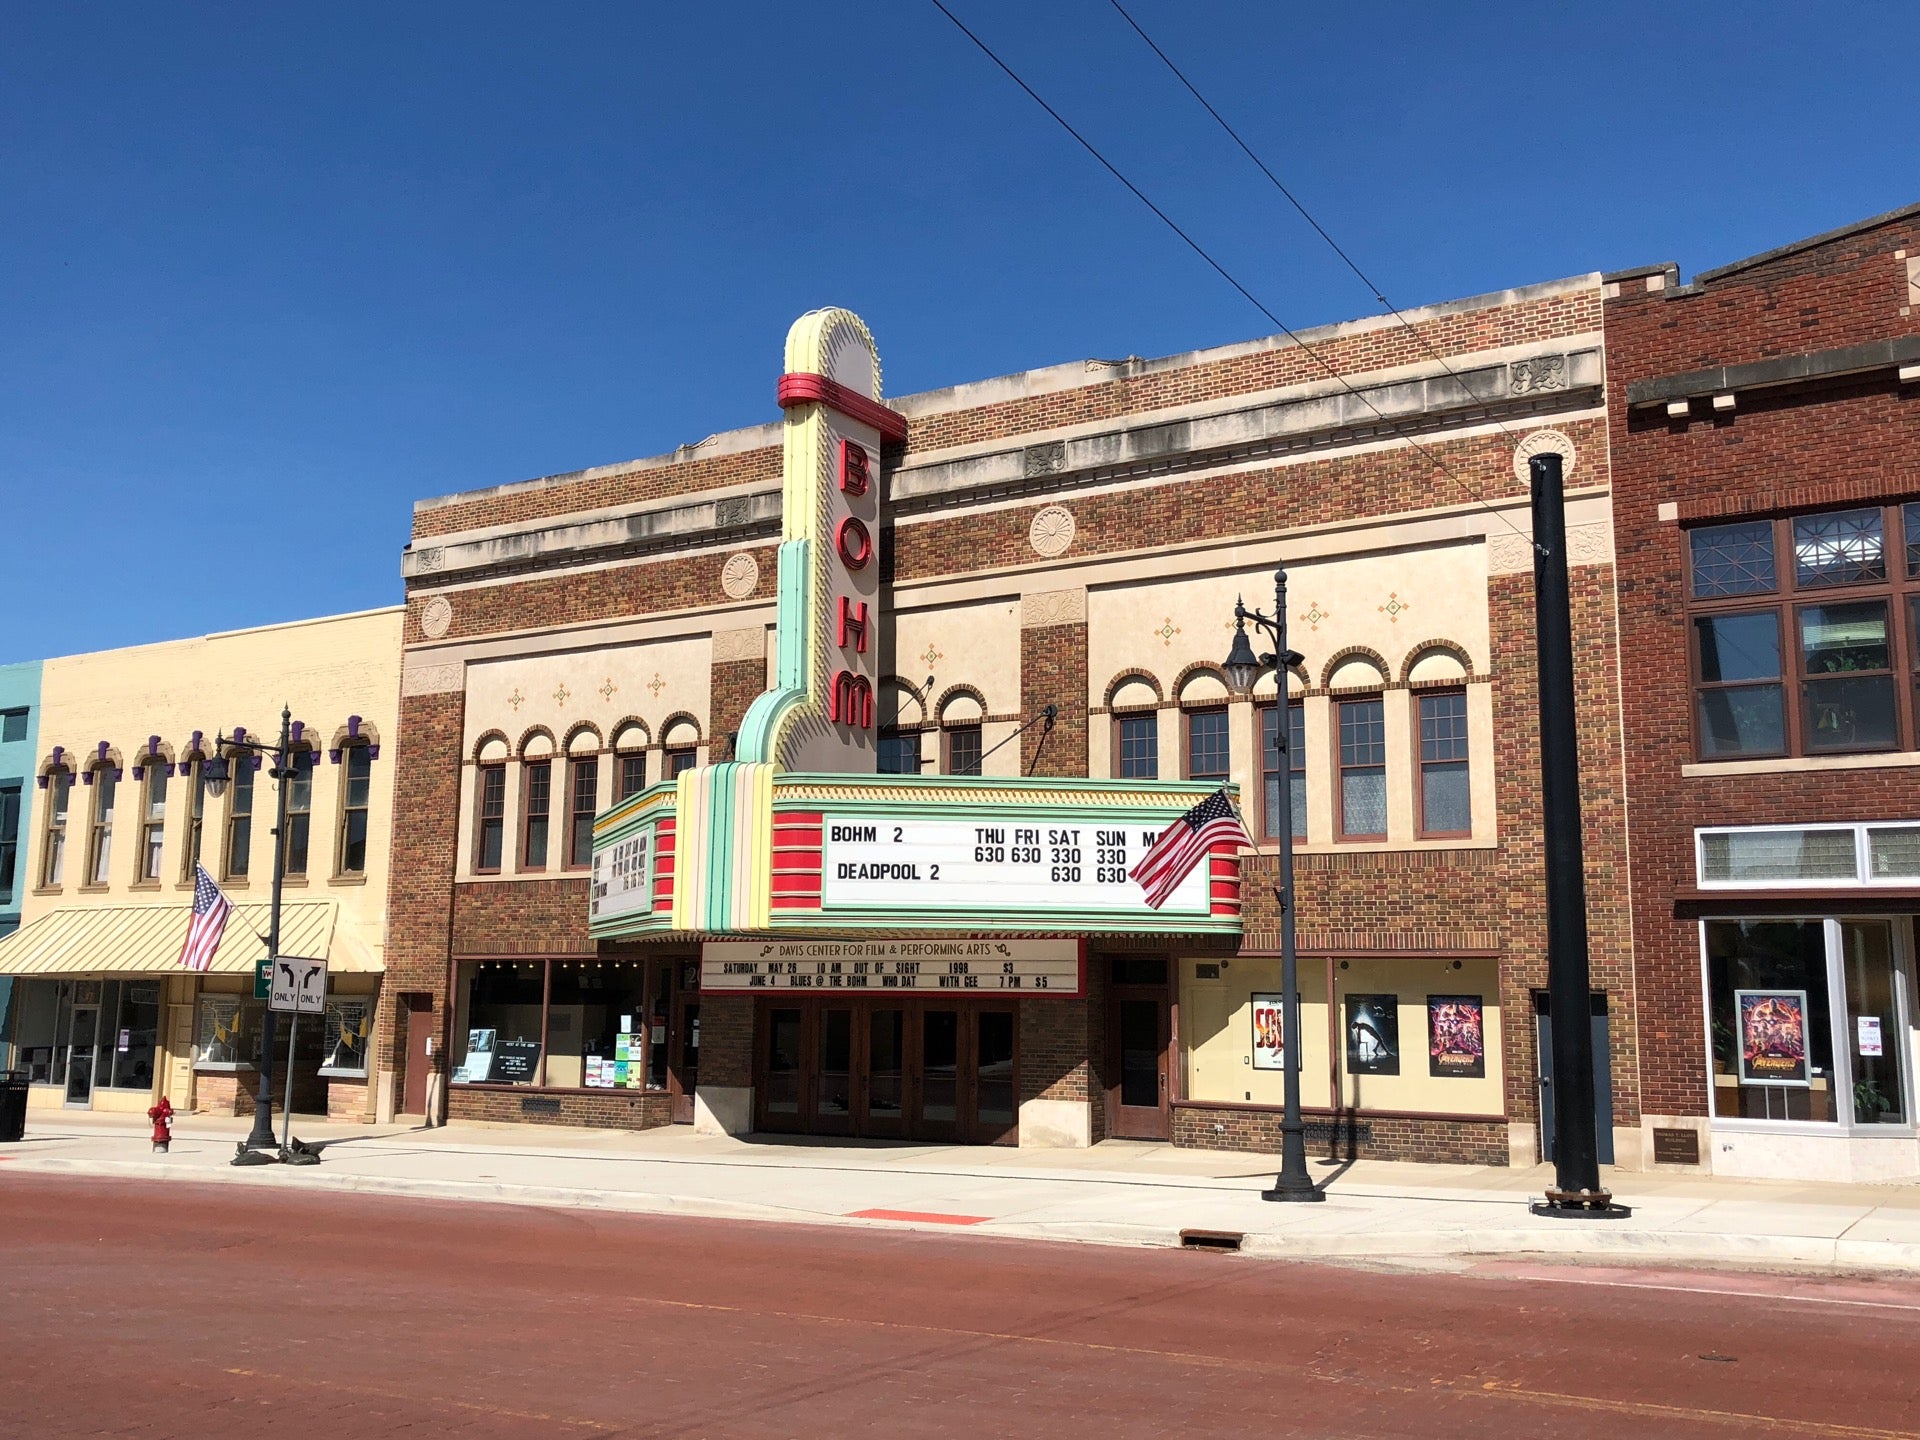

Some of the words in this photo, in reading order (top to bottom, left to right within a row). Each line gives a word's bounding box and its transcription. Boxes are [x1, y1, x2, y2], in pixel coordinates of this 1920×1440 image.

[830, 439, 873, 729] BOHM
[831, 826, 877, 842] BOHM
[893, 827, 903, 842] 2
[975, 828, 1005, 844] THU
[1015, 829, 1039, 845] FRI
[1049, 830, 1080, 845] SAT
[1096, 831, 1126, 846] SUN
[975, 846, 1005, 862] 630
[1011, 847, 1041, 863] 630
[1051, 848, 1081, 864] 330
[1096, 849, 1126, 865] 330
[837, 863, 921, 880] DEADPOOL
[930, 864, 940, 880] 2
[1051, 866, 1081, 882] 630
[1096, 867, 1127, 883] 630
[779, 945, 804, 956] DAVIS
[806, 945, 840, 956] CENTER
[843, 945, 863, 956] FOR
[865, 945, 885, 956] FILM
[889, 944, 897, 954] &
[901, 943, 963, 955] PERFORMING
[966, 943, 991, 955] ARTS
[723, 962, 758, 974] SATURDAY
[768, 963, 783, 974] MAY
[787, 962, 797, 974] 26
[817, 962, 826, 974] 10
[831, 962, 841, 974] AM
[854, 962, 868, 974] OUT
[875, 962, 884, 974] OF
[895, 962, 920, 974] SIGHT
[949, 962, 968, 974] 1998
[749, 975, 766, 987] JUNE
[770, 975, 776, 986] 4
[790, 975, 812, 987] BLUES
[816, 976, 824, 986] @
[829, 975, 842, 987] THE
[847, 975, 867, 987] BOHM
[882, 975, 898, 987] WHO
[902, 976, 916, 987] DAT
[939, 976, 960, 988] WITH
[964, 976, 978, 988] GEE
[999, 976, 1004, 988] 7
[1009, 976, 1021, 988] PM
[274, 992, 296, 1002] ONLY
[300, 994, 321, 1004] ONLY
